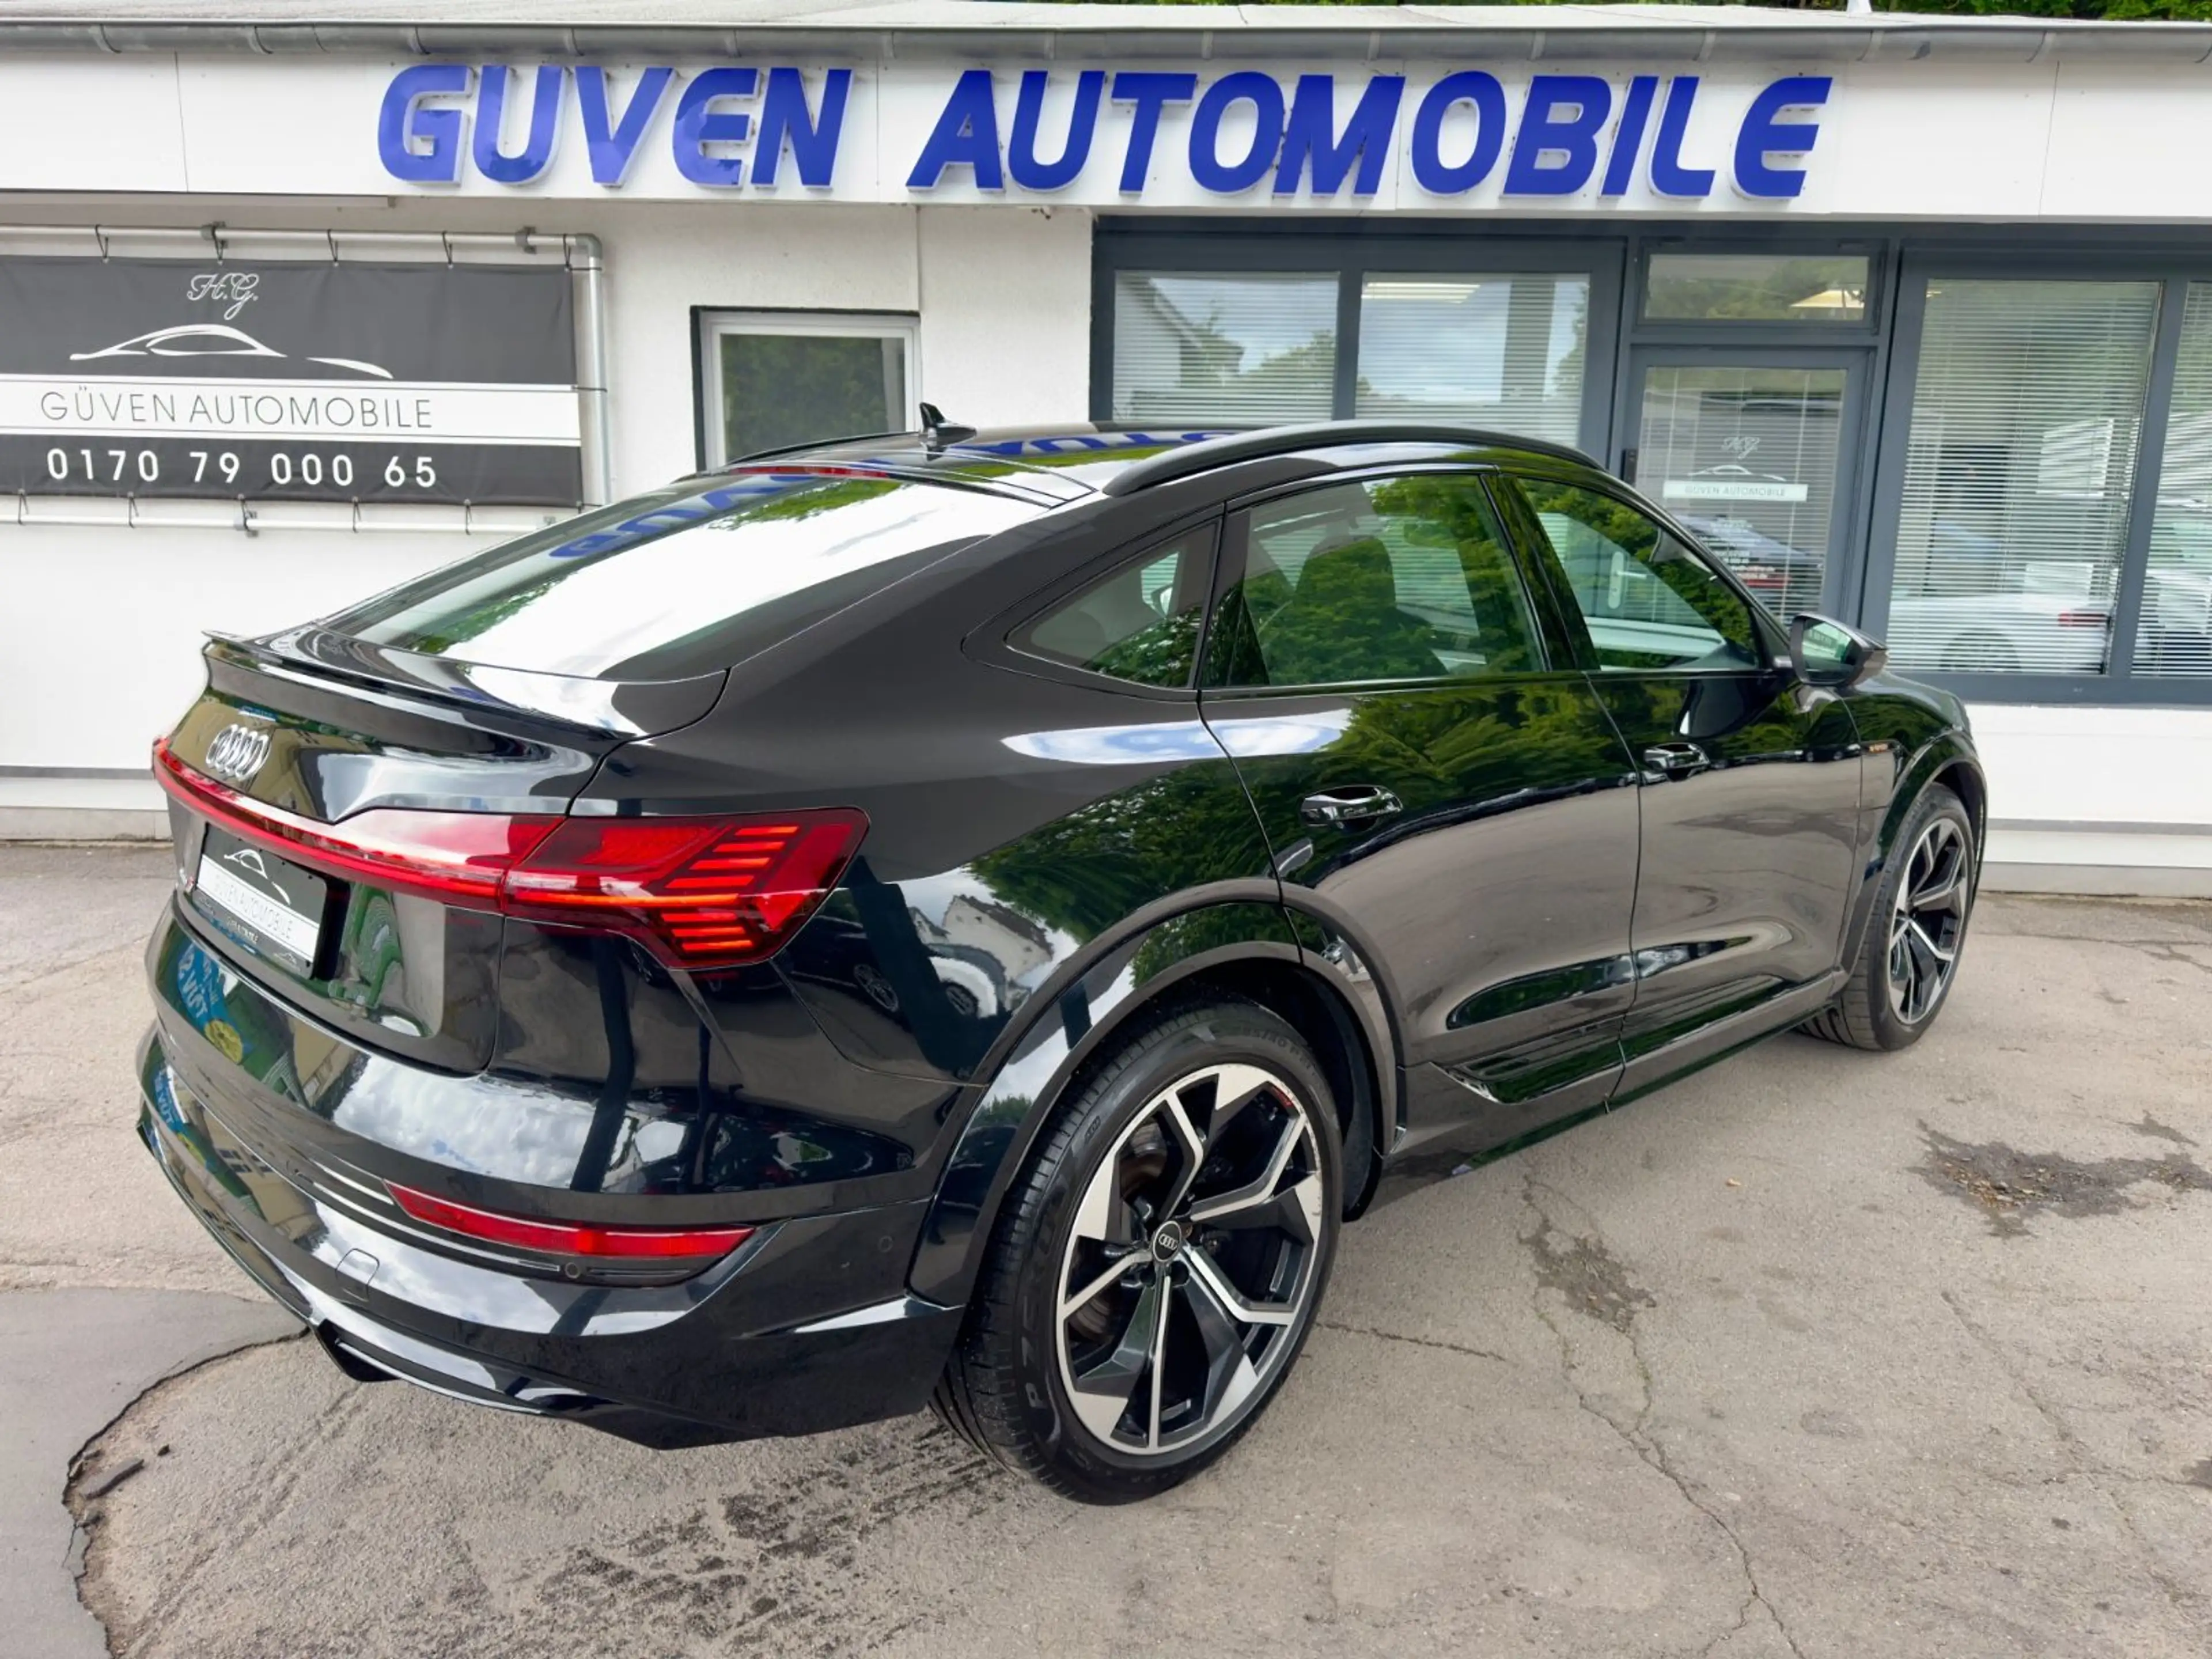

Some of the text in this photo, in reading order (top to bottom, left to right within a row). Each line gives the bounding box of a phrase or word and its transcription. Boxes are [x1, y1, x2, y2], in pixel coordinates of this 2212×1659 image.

[377, 64, 1834, 200] GUVEN AUTOMOBILE
[41, 385, 433, 429] GÜVEN AUTOMOBILE
[47, 448, 437, 488] 0170 79 000 65
